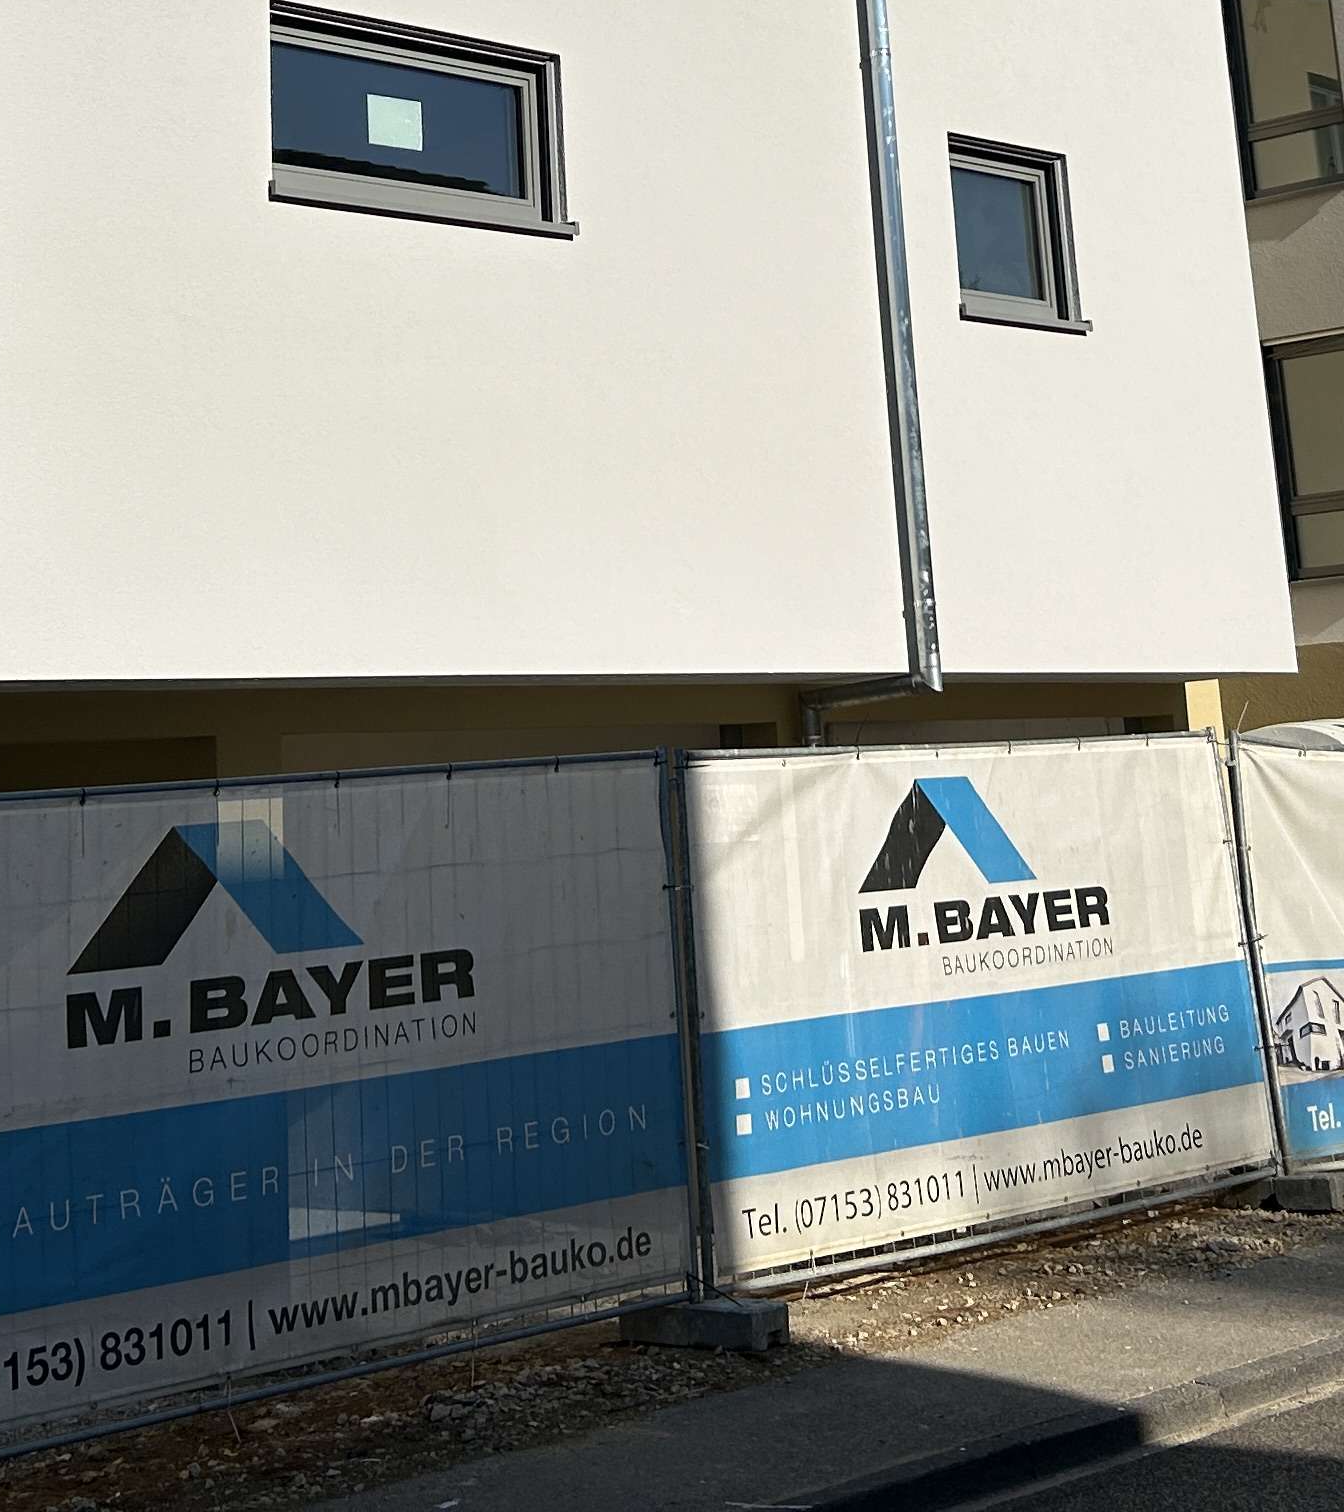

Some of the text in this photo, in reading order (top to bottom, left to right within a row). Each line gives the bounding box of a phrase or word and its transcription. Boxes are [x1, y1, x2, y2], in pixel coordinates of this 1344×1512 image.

[933, 886, 1111, 944] BAYER
[942, 937, 1114, 976] BAUKOORDINATION
[189, 948, 475, 1034] BAYER
[188, 1011, 477, 1074] BAUKOORDINATION
[1119, 1004, 1230, 1039] BAULEITUNG
[761, 1030, 1070, 1096] SCHLÜSSELFERTIGES BAUEN
[1124, 1036, 1225, 1071] SANIERUNG
[765, 1084, 941, 1131] WOHNUNGSBAU
[1306, 1102, 1341, 1132] Tel.
[313, 1153, 355, 1187] IN
[391, 1134, 465, 1175] DER
[496, 1103, 648, 1156] REGION
[742, 1202, 788, 1239] Tel.
[794, 1184, 882, 1235] (07153)
[887, 1170, 964, 1211] 831011
[983, 1122, 1204, 1192] www.mbayer-bauko.de
[99, 1310, 231, 1372] 831011
[268, 1226, 652, 1335] www.mbayer-bauko.de
